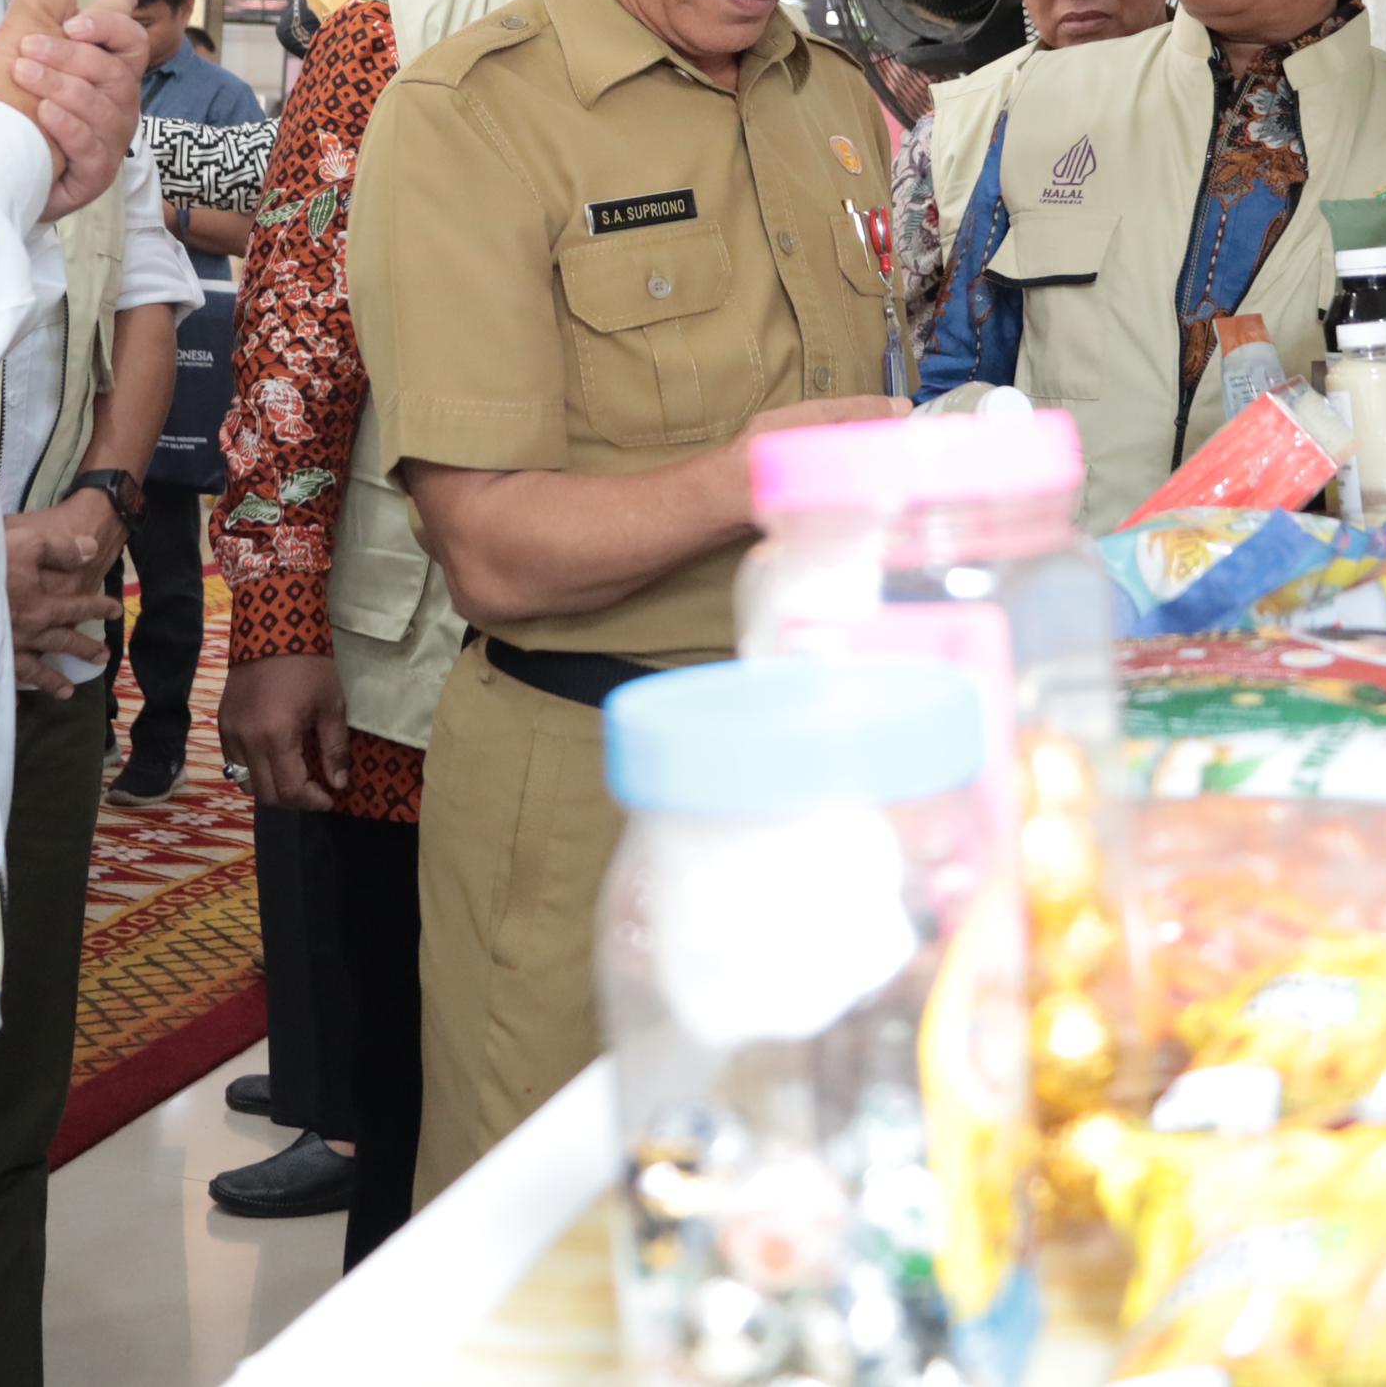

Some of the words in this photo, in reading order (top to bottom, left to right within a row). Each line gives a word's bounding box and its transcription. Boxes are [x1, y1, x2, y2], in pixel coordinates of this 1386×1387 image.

[1042, 188, 1084, 199] HALAL
[601, 209, 626, 225] S.A.
[626, 199, 686, 221] SUPRIONO
[176, 349, 214, 362] ONESIA
